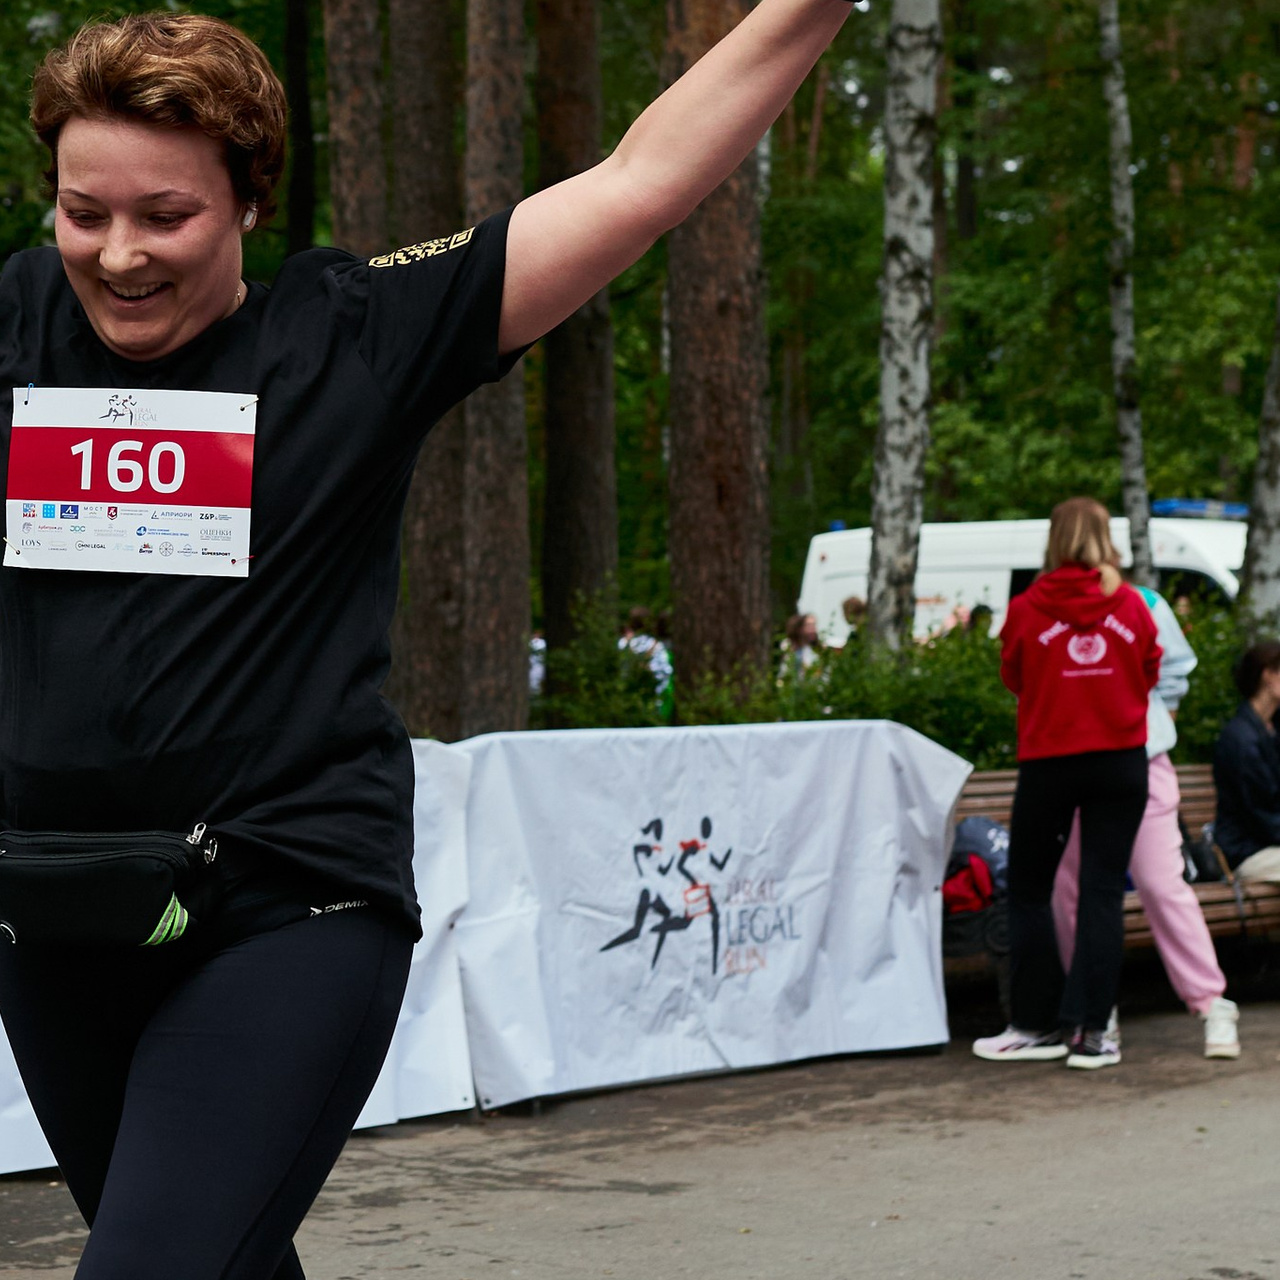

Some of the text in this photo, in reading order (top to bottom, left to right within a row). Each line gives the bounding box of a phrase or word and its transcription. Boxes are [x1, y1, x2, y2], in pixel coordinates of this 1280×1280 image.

[70, 438, 186, 494] 160
[324, 900, 368, 913] DEMIX
[725, 903, 802, 945] LEGAL
